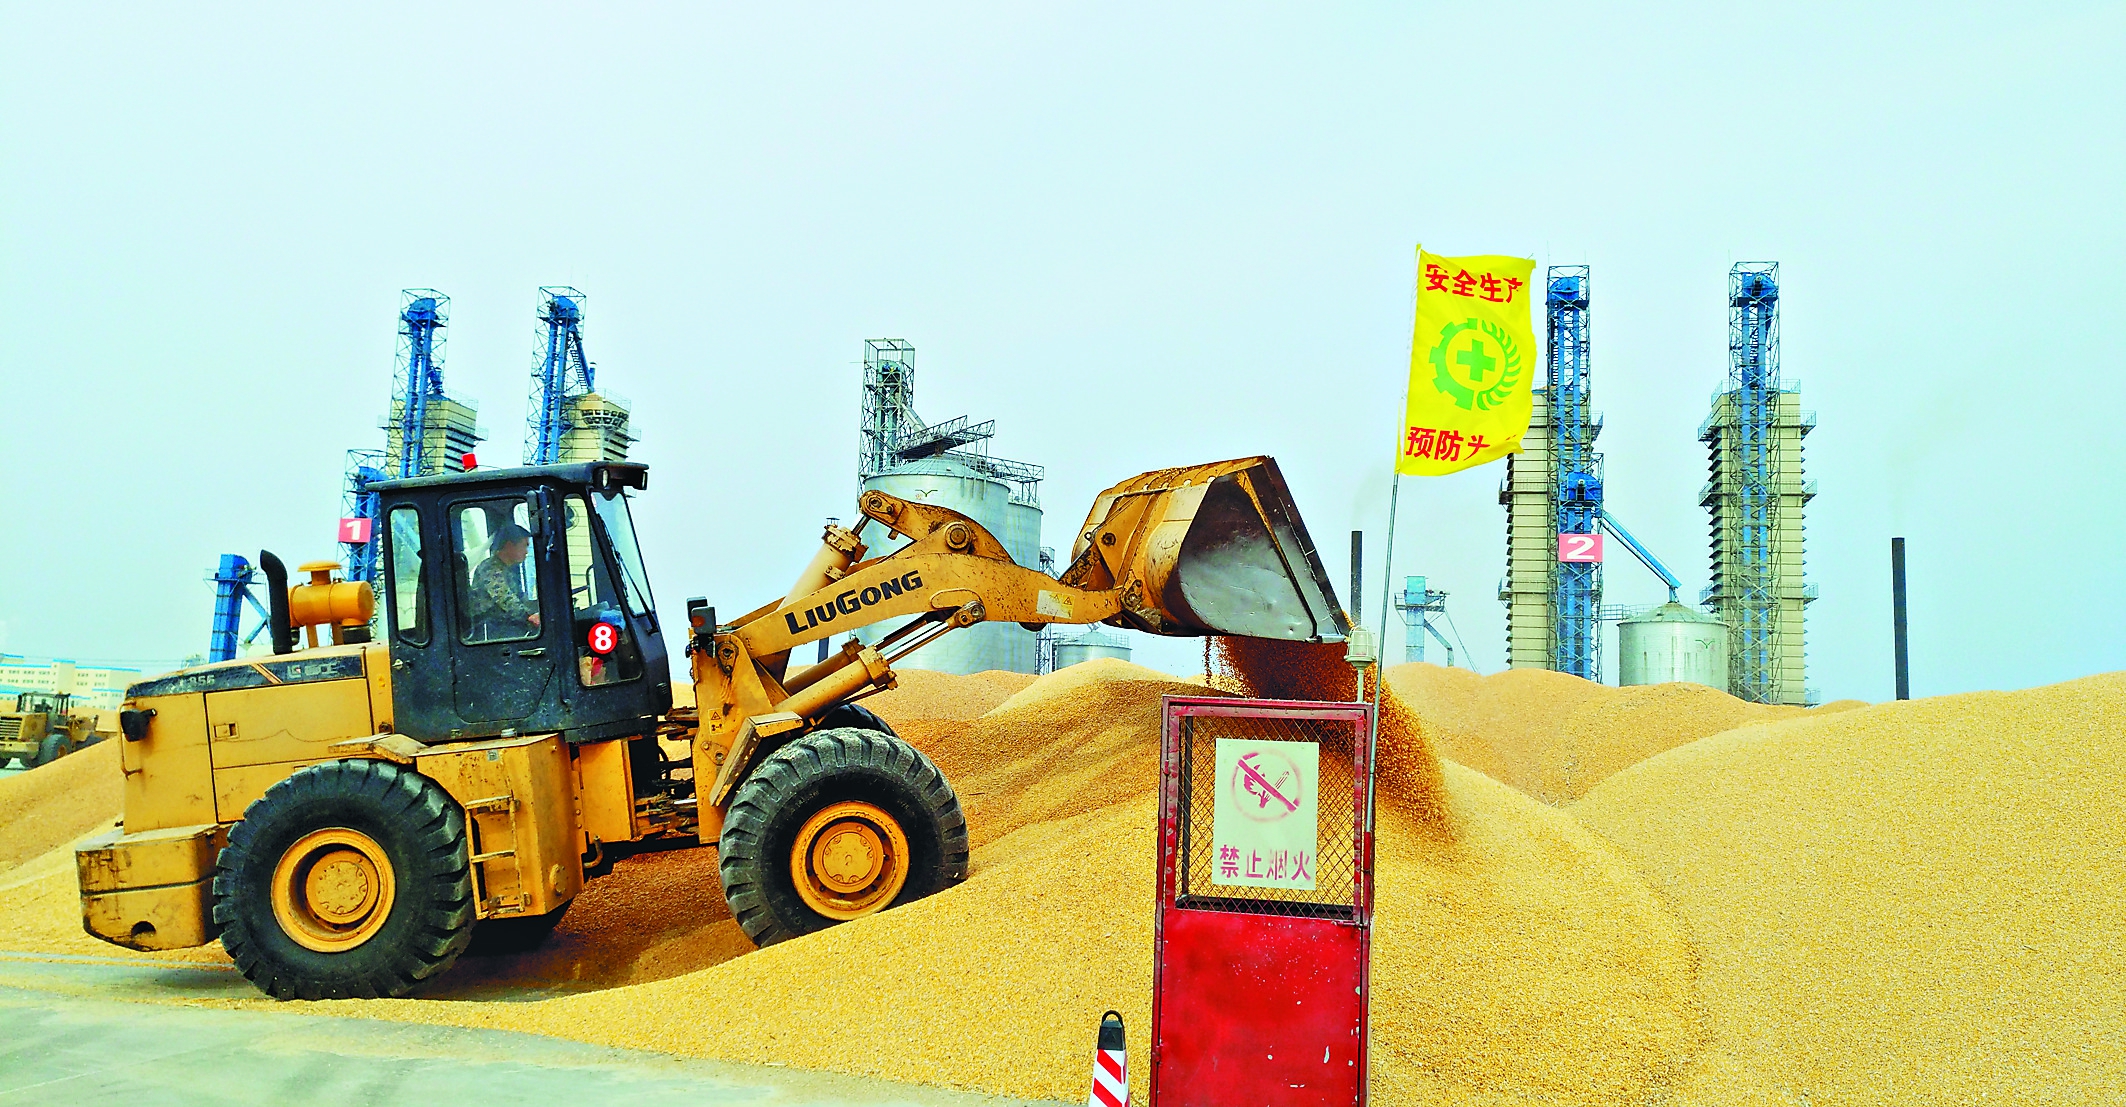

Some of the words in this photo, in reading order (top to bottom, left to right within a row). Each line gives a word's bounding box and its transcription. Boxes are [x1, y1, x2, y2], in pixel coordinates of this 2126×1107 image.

[1425, 264, 1523, 303] 安全生产
[346, 520, 361, 540] 1
[1566, 536, 1595, 559] 2
[595, 626, 612, 650] 8
